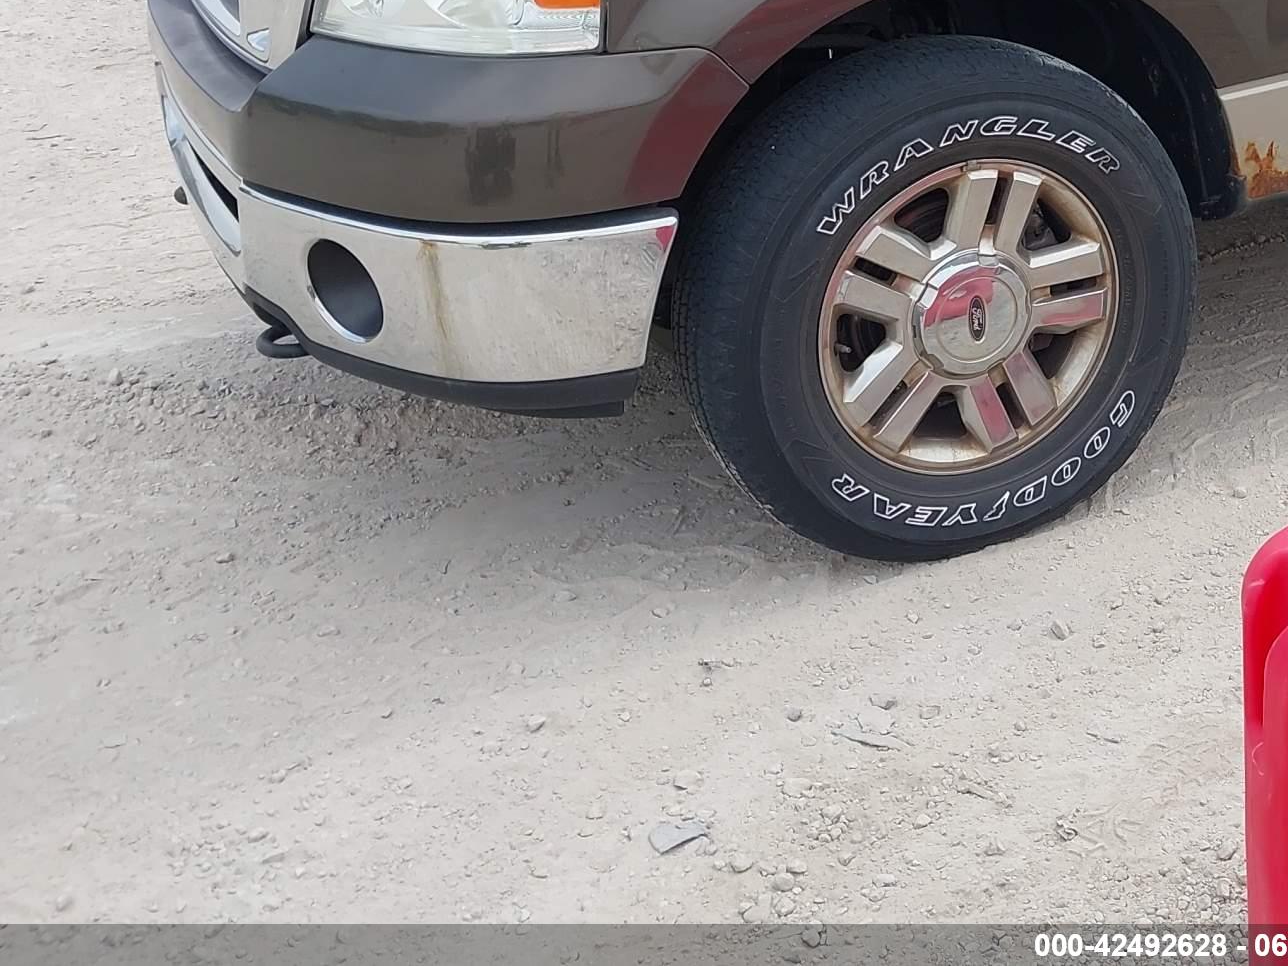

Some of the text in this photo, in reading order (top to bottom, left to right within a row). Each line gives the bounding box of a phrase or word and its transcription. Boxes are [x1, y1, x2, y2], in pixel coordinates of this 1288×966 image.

[816, 115, 1121, 237] WRANGLER
[971, 307, 983, 331] Ford
[831, 389, 1137, 528] GOODYEAR
